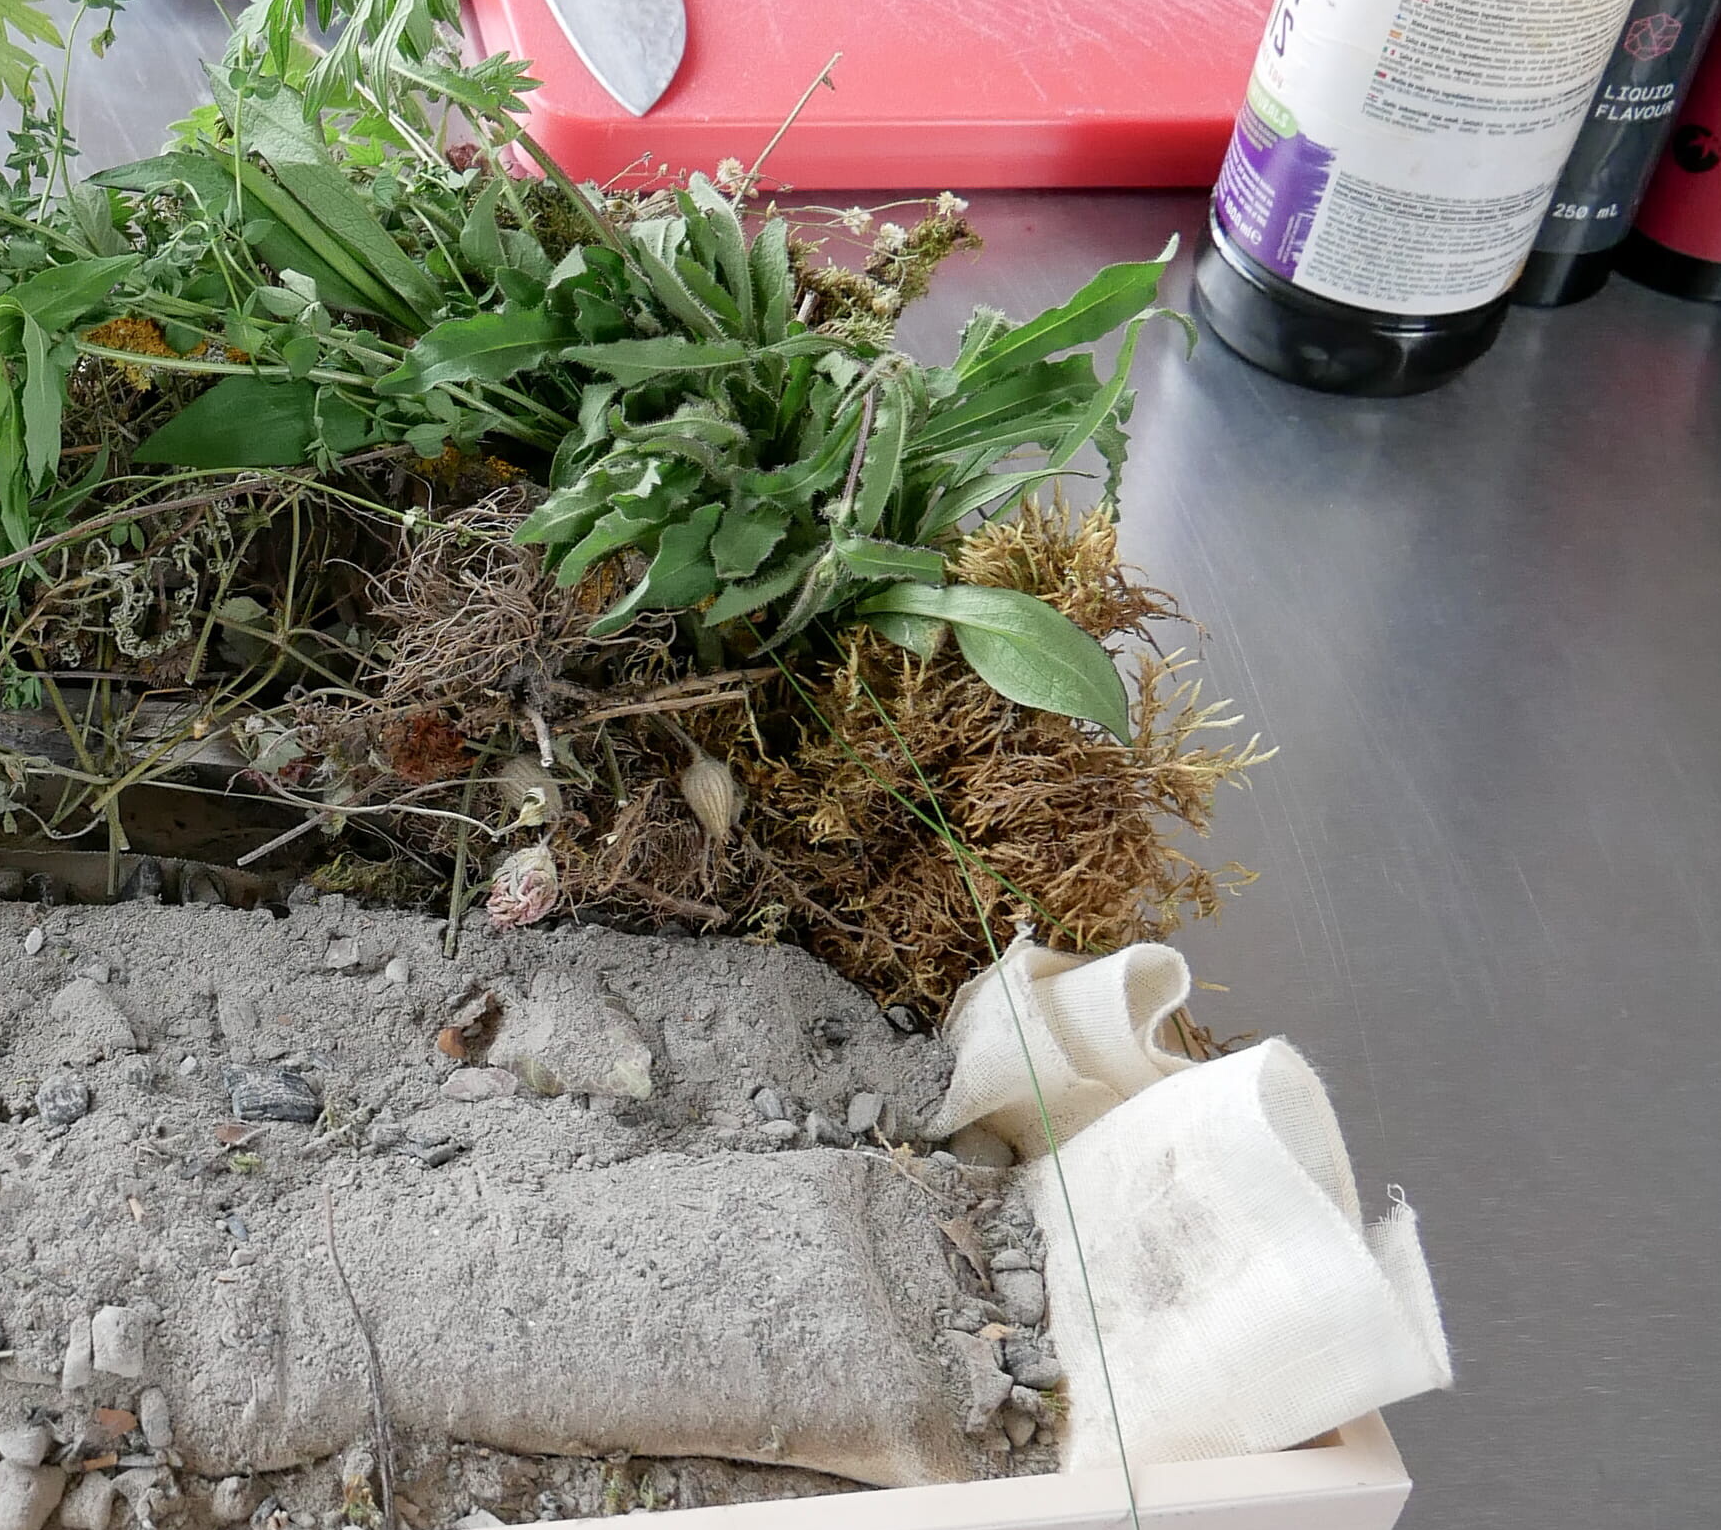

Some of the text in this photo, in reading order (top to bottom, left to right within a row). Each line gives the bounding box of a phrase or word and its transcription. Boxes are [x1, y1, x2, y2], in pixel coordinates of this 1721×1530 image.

[1604, 82, 1674, 102] LIQUID
[1594, 99, 1676, 121] FLAVOUR
[1552, 203, 1619, 220] 250 ml
